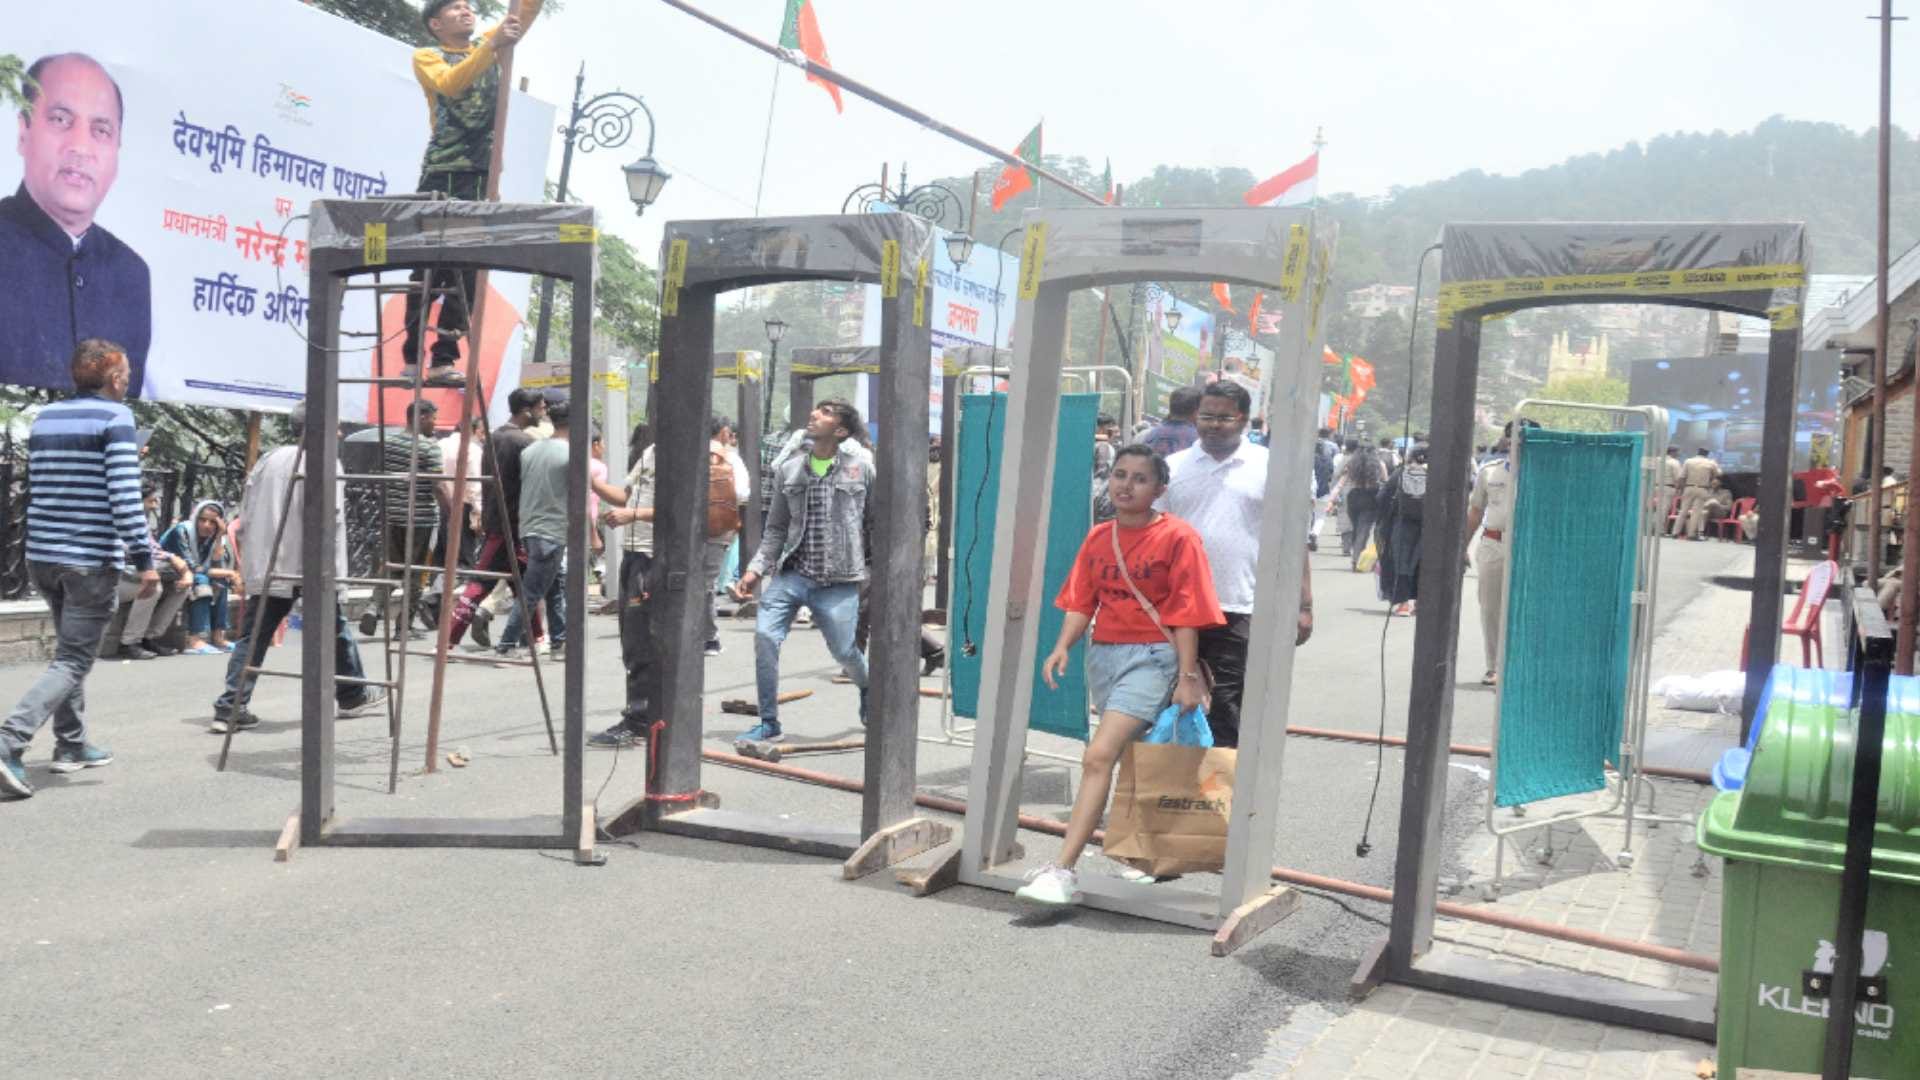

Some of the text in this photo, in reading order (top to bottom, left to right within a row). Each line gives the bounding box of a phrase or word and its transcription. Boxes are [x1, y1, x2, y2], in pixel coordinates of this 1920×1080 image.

[173, 110, 246, 173] देवभूमि
[252, 134, 327, 191] हिमाचल
[274, 196, 294, 217] पर
[162, 207, 228, 242] प्रधानमंत्री
[235, 220, 289, 268] नरेन्द्र
[193, 272, 257, 317] हार्दिक
